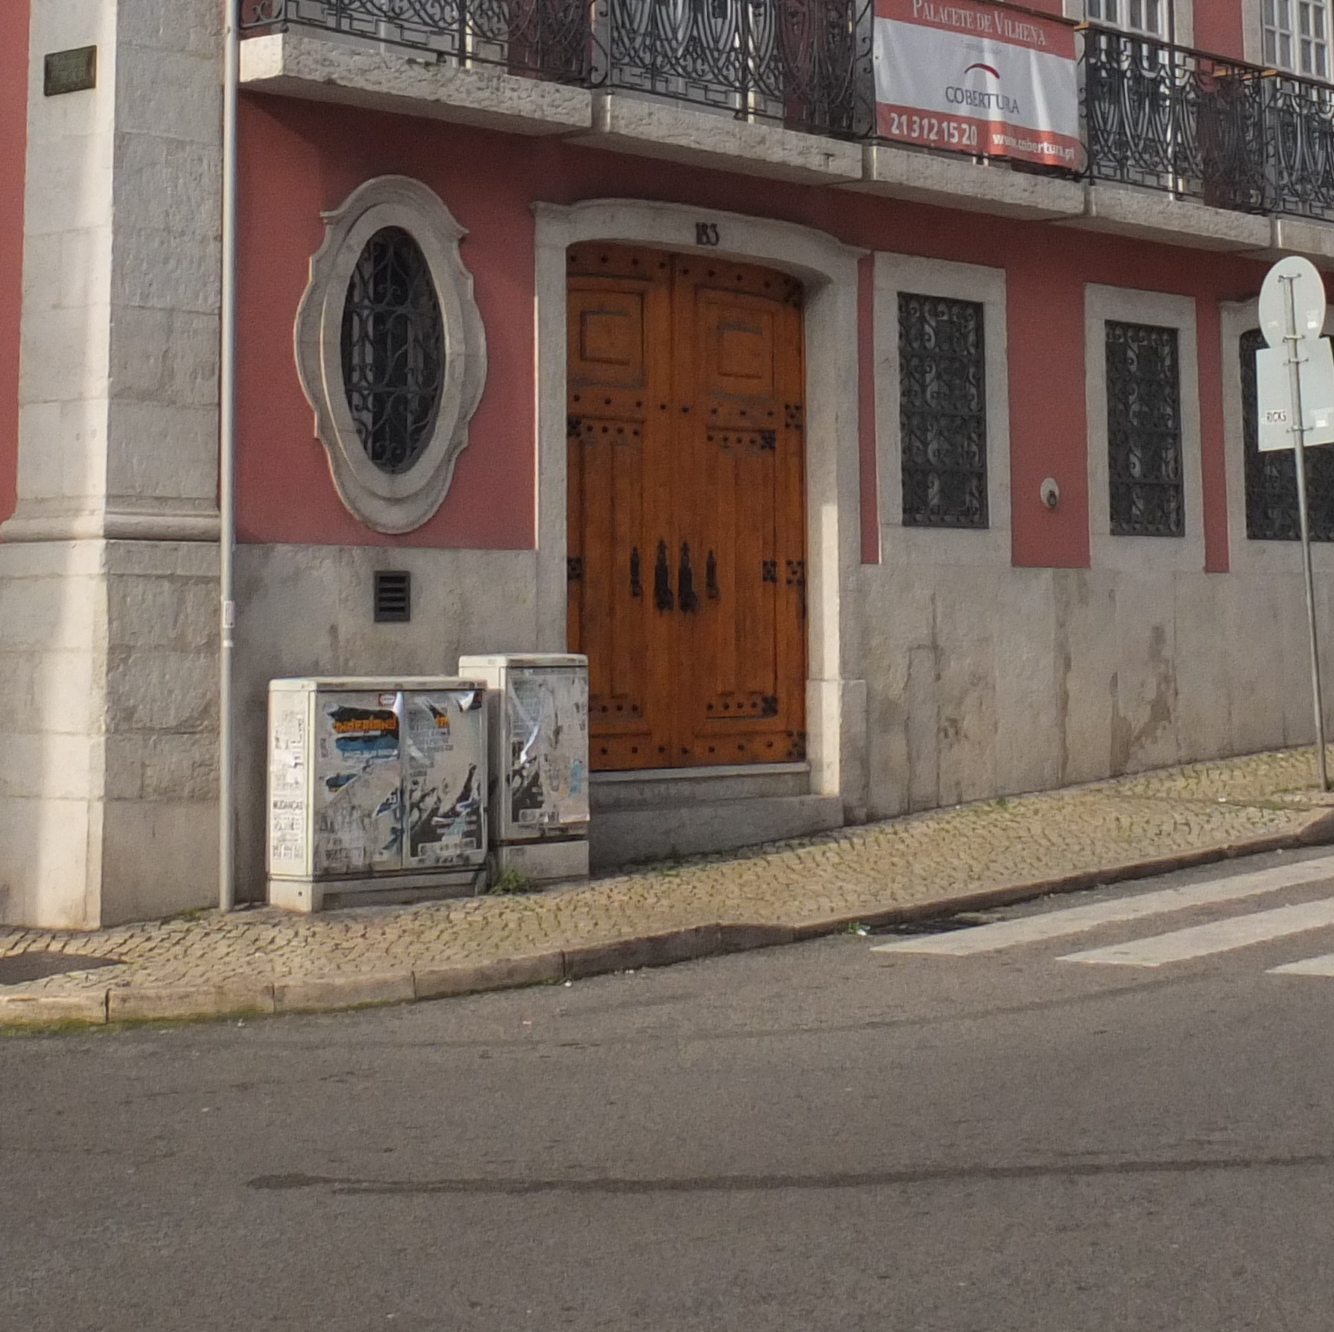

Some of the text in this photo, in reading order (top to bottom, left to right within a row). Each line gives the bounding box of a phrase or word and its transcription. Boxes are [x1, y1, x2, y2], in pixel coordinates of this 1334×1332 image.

[976, 11, 993, 33] DE
[993, 10, 1046, 46] VILHENA
[945, 86, 1020, 115] COBERTURA
[890, 112, 978, 145] 21 312 15 20
[992, 132, 1075, 159] www.cobertura.pt
